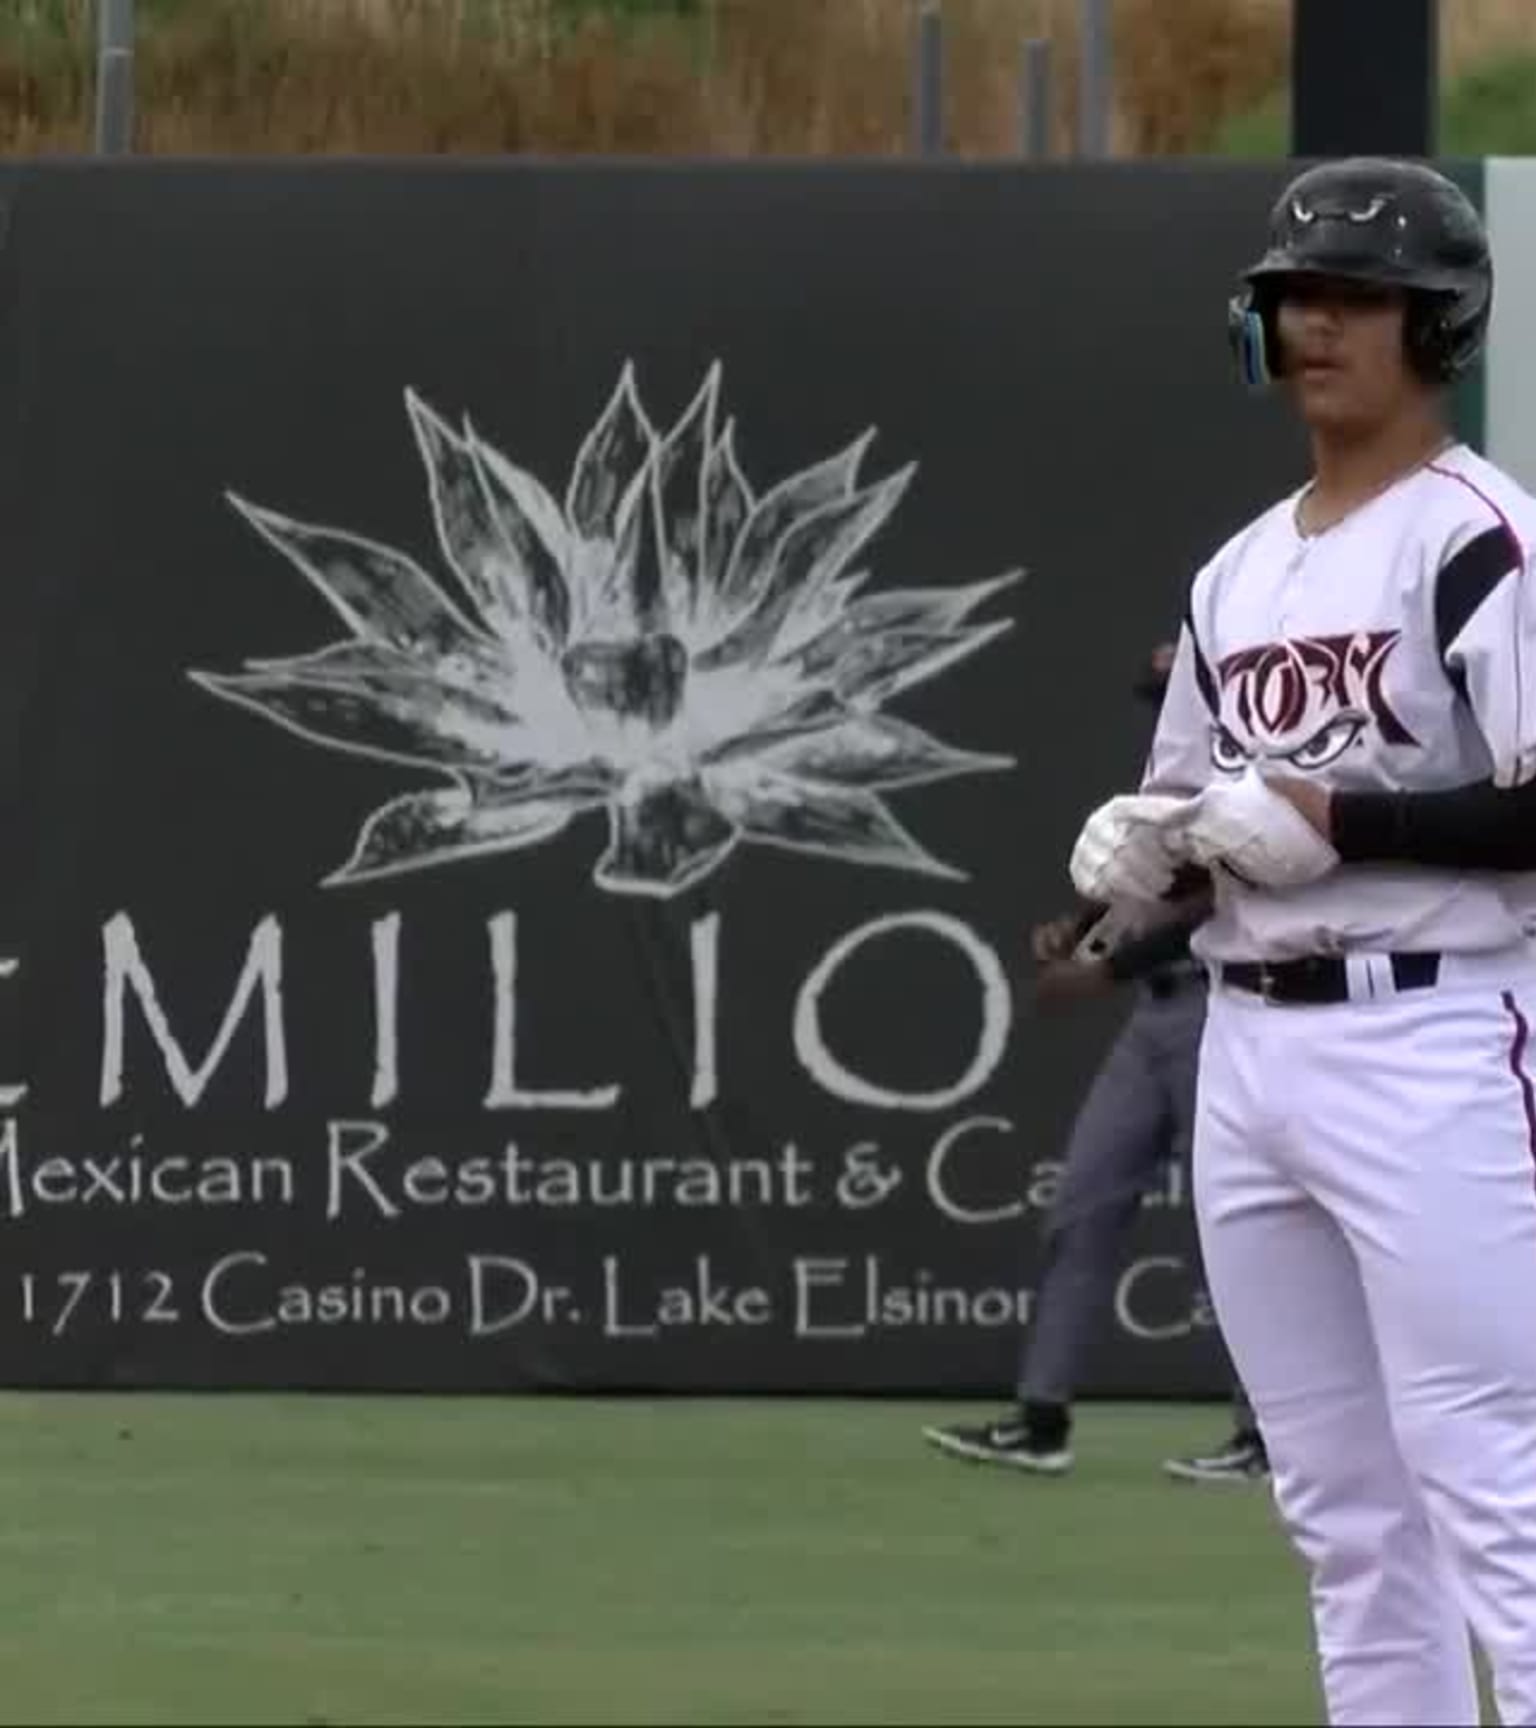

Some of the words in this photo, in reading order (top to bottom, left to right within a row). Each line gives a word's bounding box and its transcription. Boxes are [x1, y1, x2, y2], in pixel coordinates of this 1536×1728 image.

[0, 909, 1013, 1112] MILIO
[326, 1120, 814, 1220] Restaurant
[837, 1142, 902, 1208] &
[21, 1272, 179, 1335] 1712
[202, 1252, 452, 1333] Casino
[467, 1254, 581, 1335] Dr.
[604, 1256, 772, 1336] Lake
